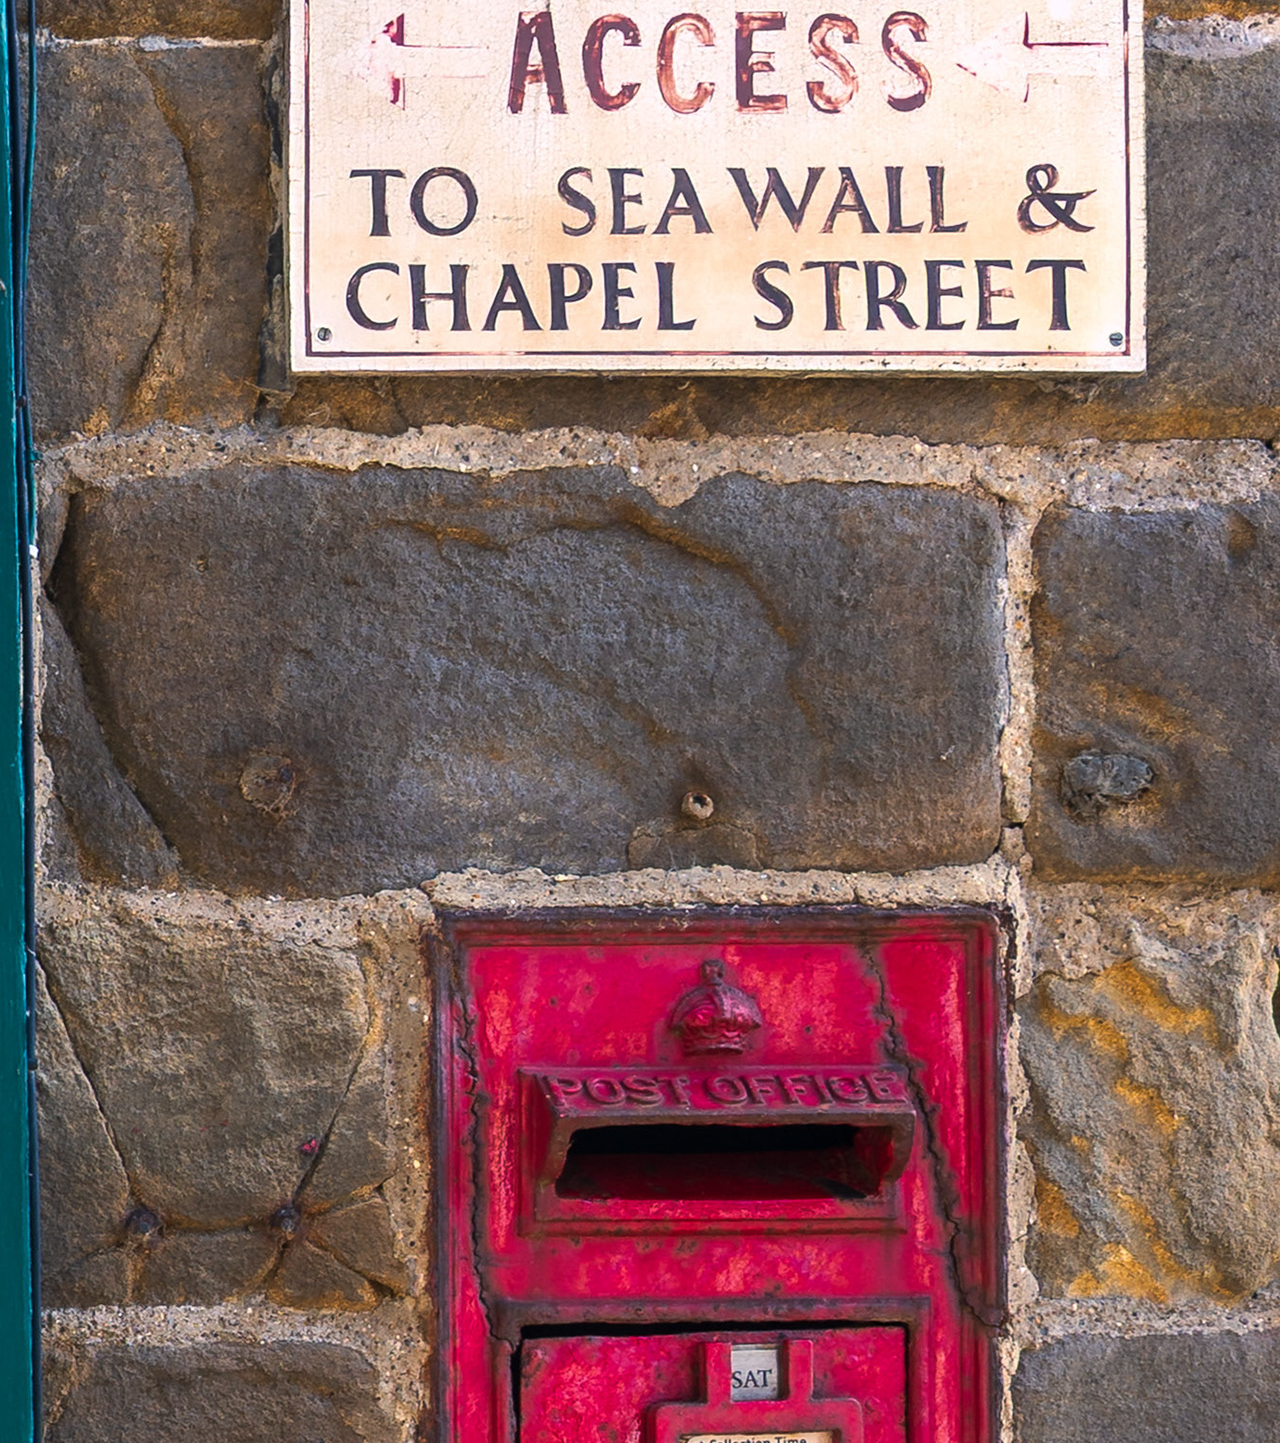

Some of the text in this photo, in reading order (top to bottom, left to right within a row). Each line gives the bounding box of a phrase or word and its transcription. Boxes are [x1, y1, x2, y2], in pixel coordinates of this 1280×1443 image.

[507, 9, 933, 115] ACCESS
[349, 165, 479, 238] TO
[1017, 163, 1098, 235] &
[346, 259, 1088, 334] CHAPEL STREET
[543, 1070, 910, 1109] POST OFFICE
[731, 1369, 773, 1389] SAT
